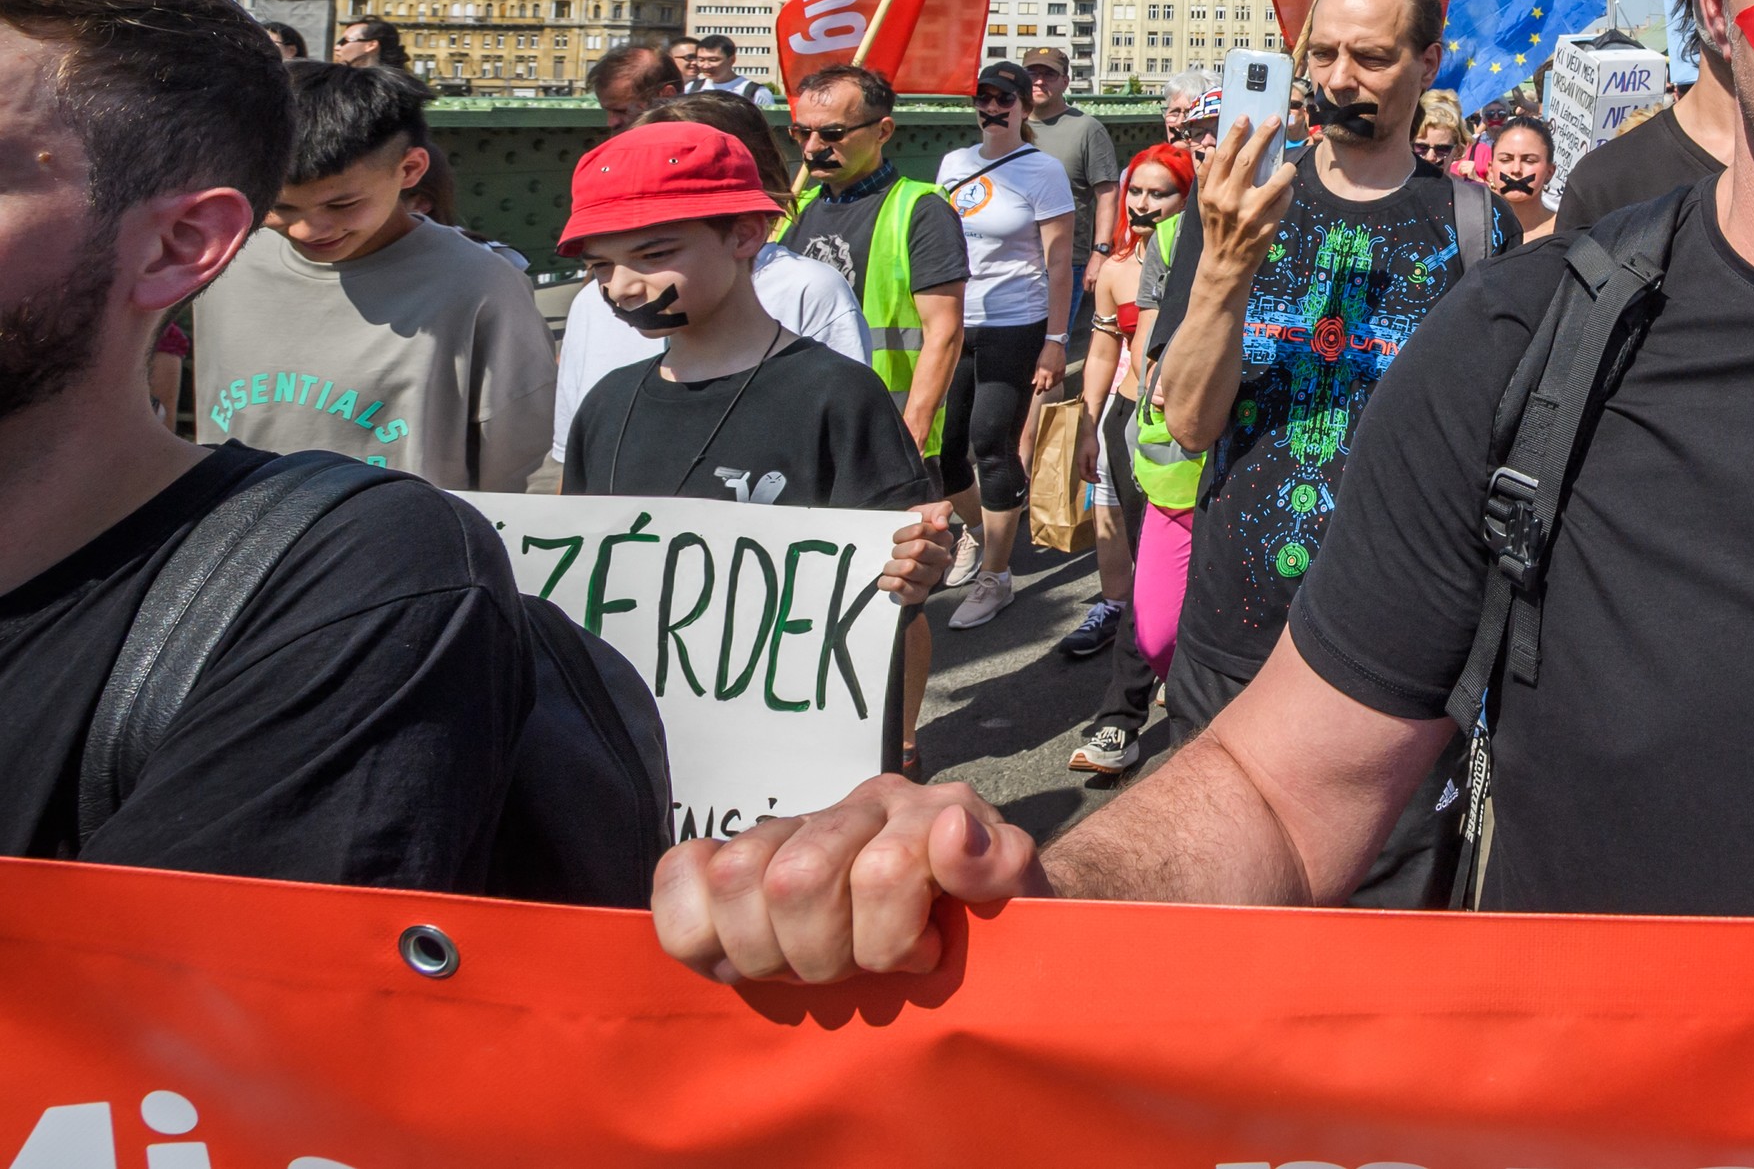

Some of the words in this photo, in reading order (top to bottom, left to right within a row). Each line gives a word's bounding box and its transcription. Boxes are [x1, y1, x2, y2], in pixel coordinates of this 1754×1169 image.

[1603, 64, 1651, 95] MÁR
[1242, 322, 1307, 342] TRIC
[210, 372, 409, 444] ESSENTIALS
